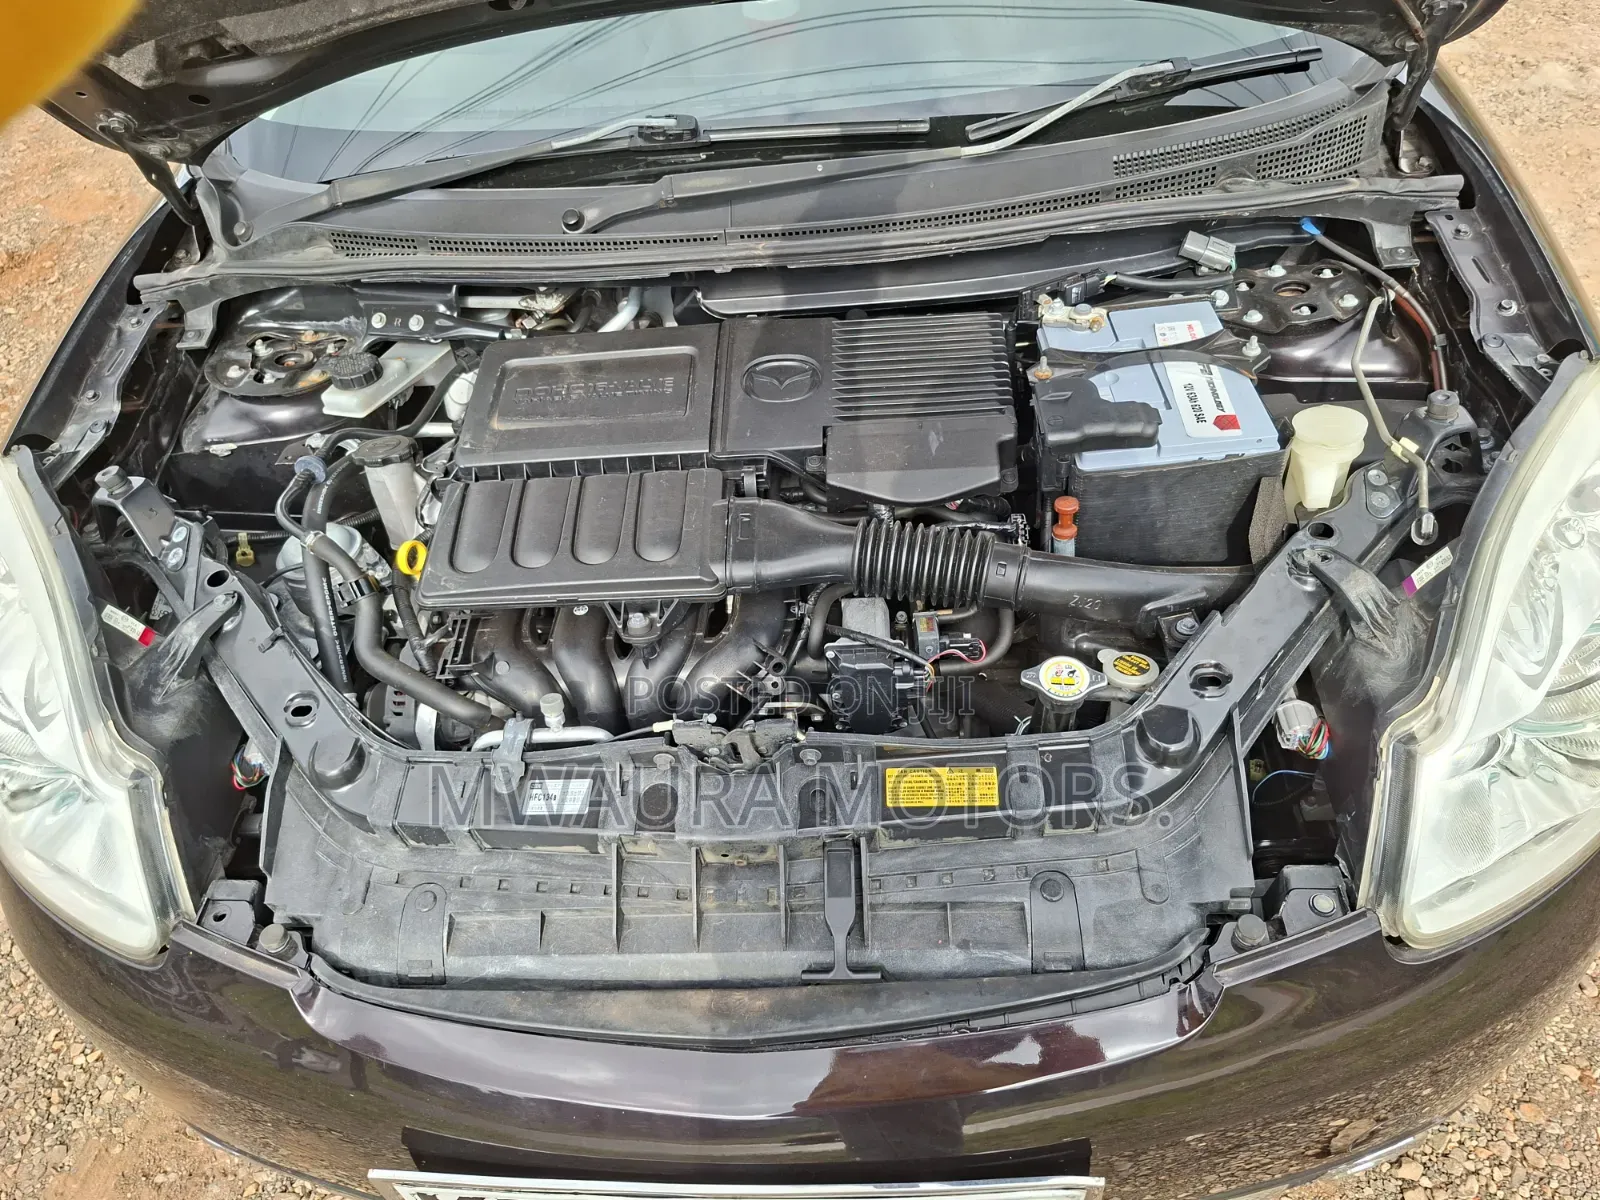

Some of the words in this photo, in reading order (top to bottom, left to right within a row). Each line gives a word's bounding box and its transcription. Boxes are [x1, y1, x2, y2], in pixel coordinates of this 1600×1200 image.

[1183, 382, 1195, 392] 12V
[1186, 391, 1199, 404] 63Ah
[1191, 403, 1204, 413] 620
[1194, 412, 1207, 424] SAE
